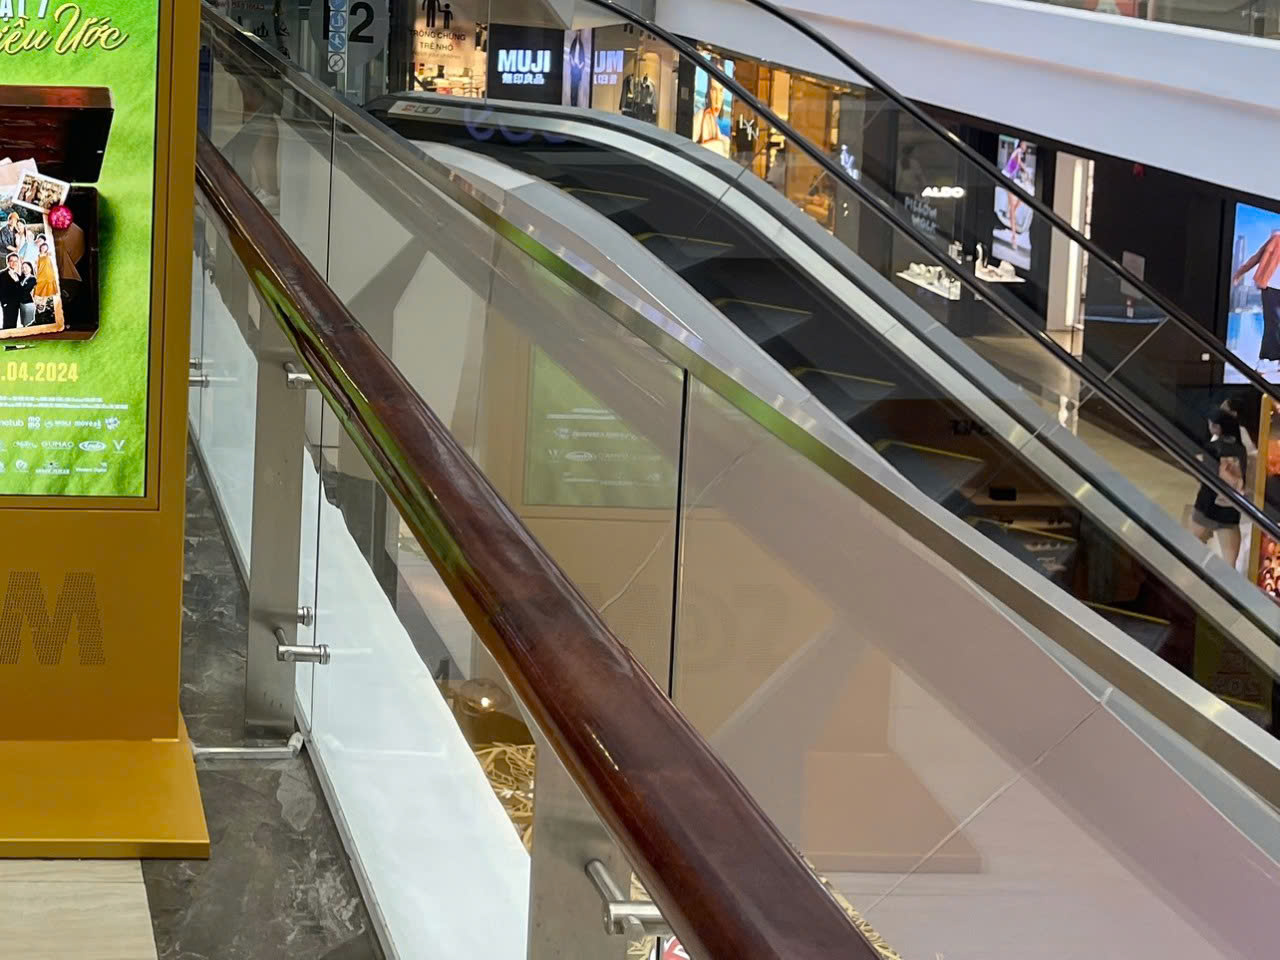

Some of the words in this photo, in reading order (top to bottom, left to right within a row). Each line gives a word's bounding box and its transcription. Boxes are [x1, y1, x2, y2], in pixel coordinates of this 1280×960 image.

[54, 2, 129, 56] Ước
[497, 49, 551, 72] MUJI
[921, 186, 965, 199] ALDO
